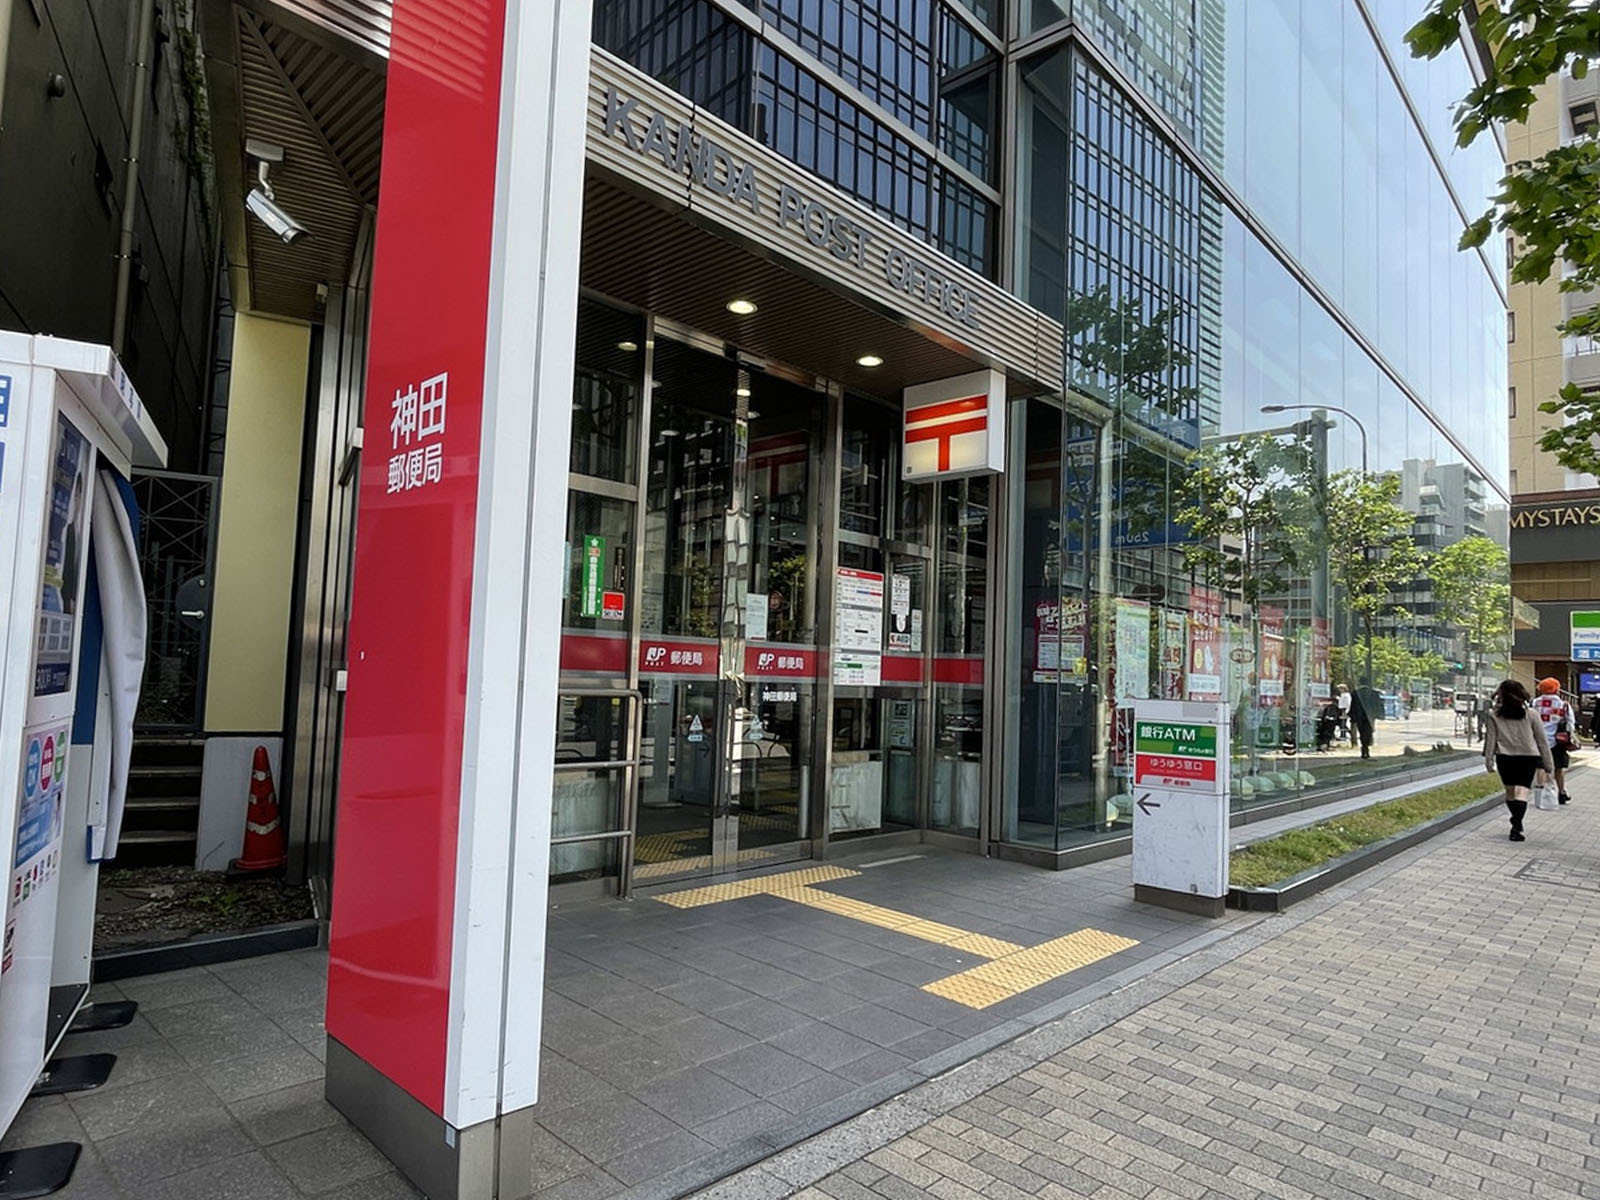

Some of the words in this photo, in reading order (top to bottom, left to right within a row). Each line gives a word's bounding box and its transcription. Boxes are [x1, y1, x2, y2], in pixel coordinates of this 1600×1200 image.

[604, 86, 763, 214] KANDA
[778, 184, 872, 269] POST
[884, 248, 982, 330] OFFICE
[391, 372, 448, 450] 神田
[387, 442, 442, 494] 郵便局
[670, 650, 703, 666] 郵便局
[1141, 725, 1196, 741] 銀行ATM
[1150, 758, 1203, 771] ゆうゆう窓口
